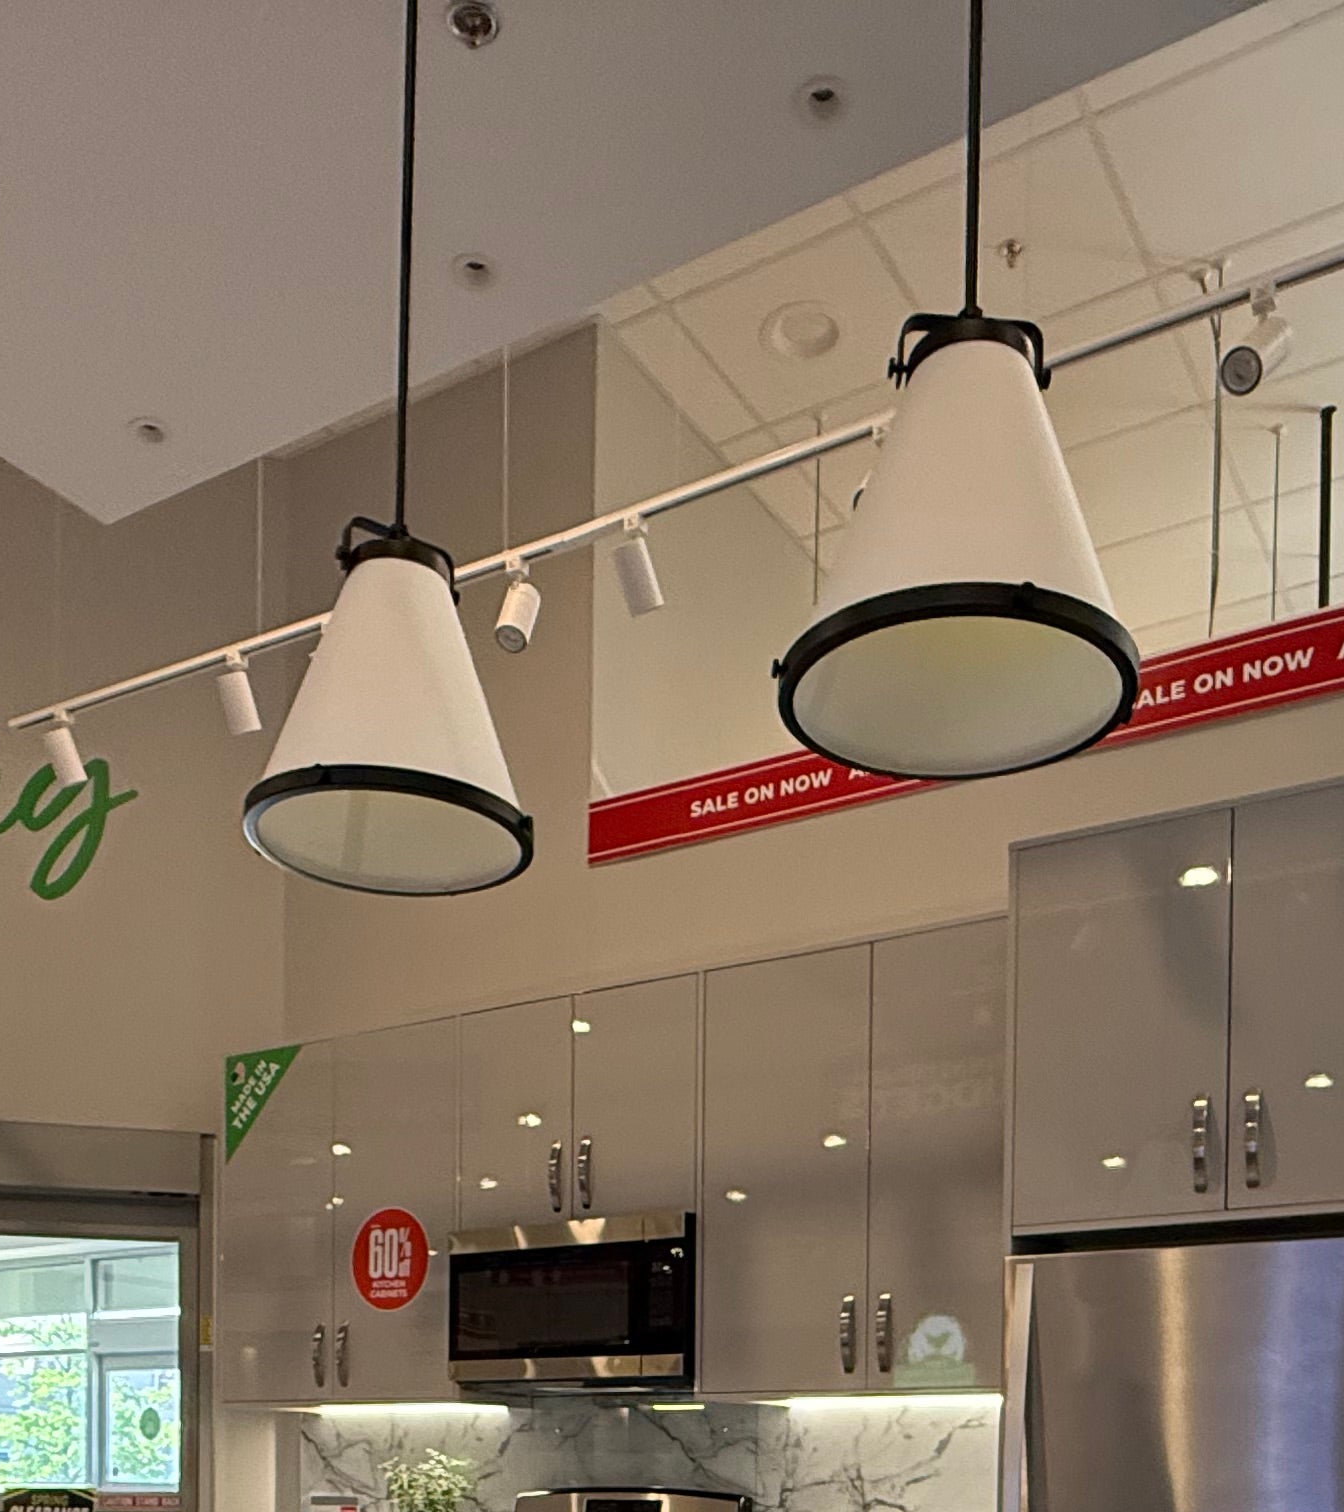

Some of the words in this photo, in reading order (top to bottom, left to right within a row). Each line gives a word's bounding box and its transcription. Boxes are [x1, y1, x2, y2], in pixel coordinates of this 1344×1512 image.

[1132, 680, 1186, 710] ALE
[1193, 667, 1234, 694] ON
[1242, 647, 1314, 683] NOW
[690, 792, 738, 818] SALE
[744, 784, 774, 805] ON
[780, 768, 833, 797] NOW
[231, 1076, 256, 1113] MADE
[254, 1060, 267, 1076] IN
[232, 1096, 257, 1129] THE
[254, 1062, 280, 1095] USA
